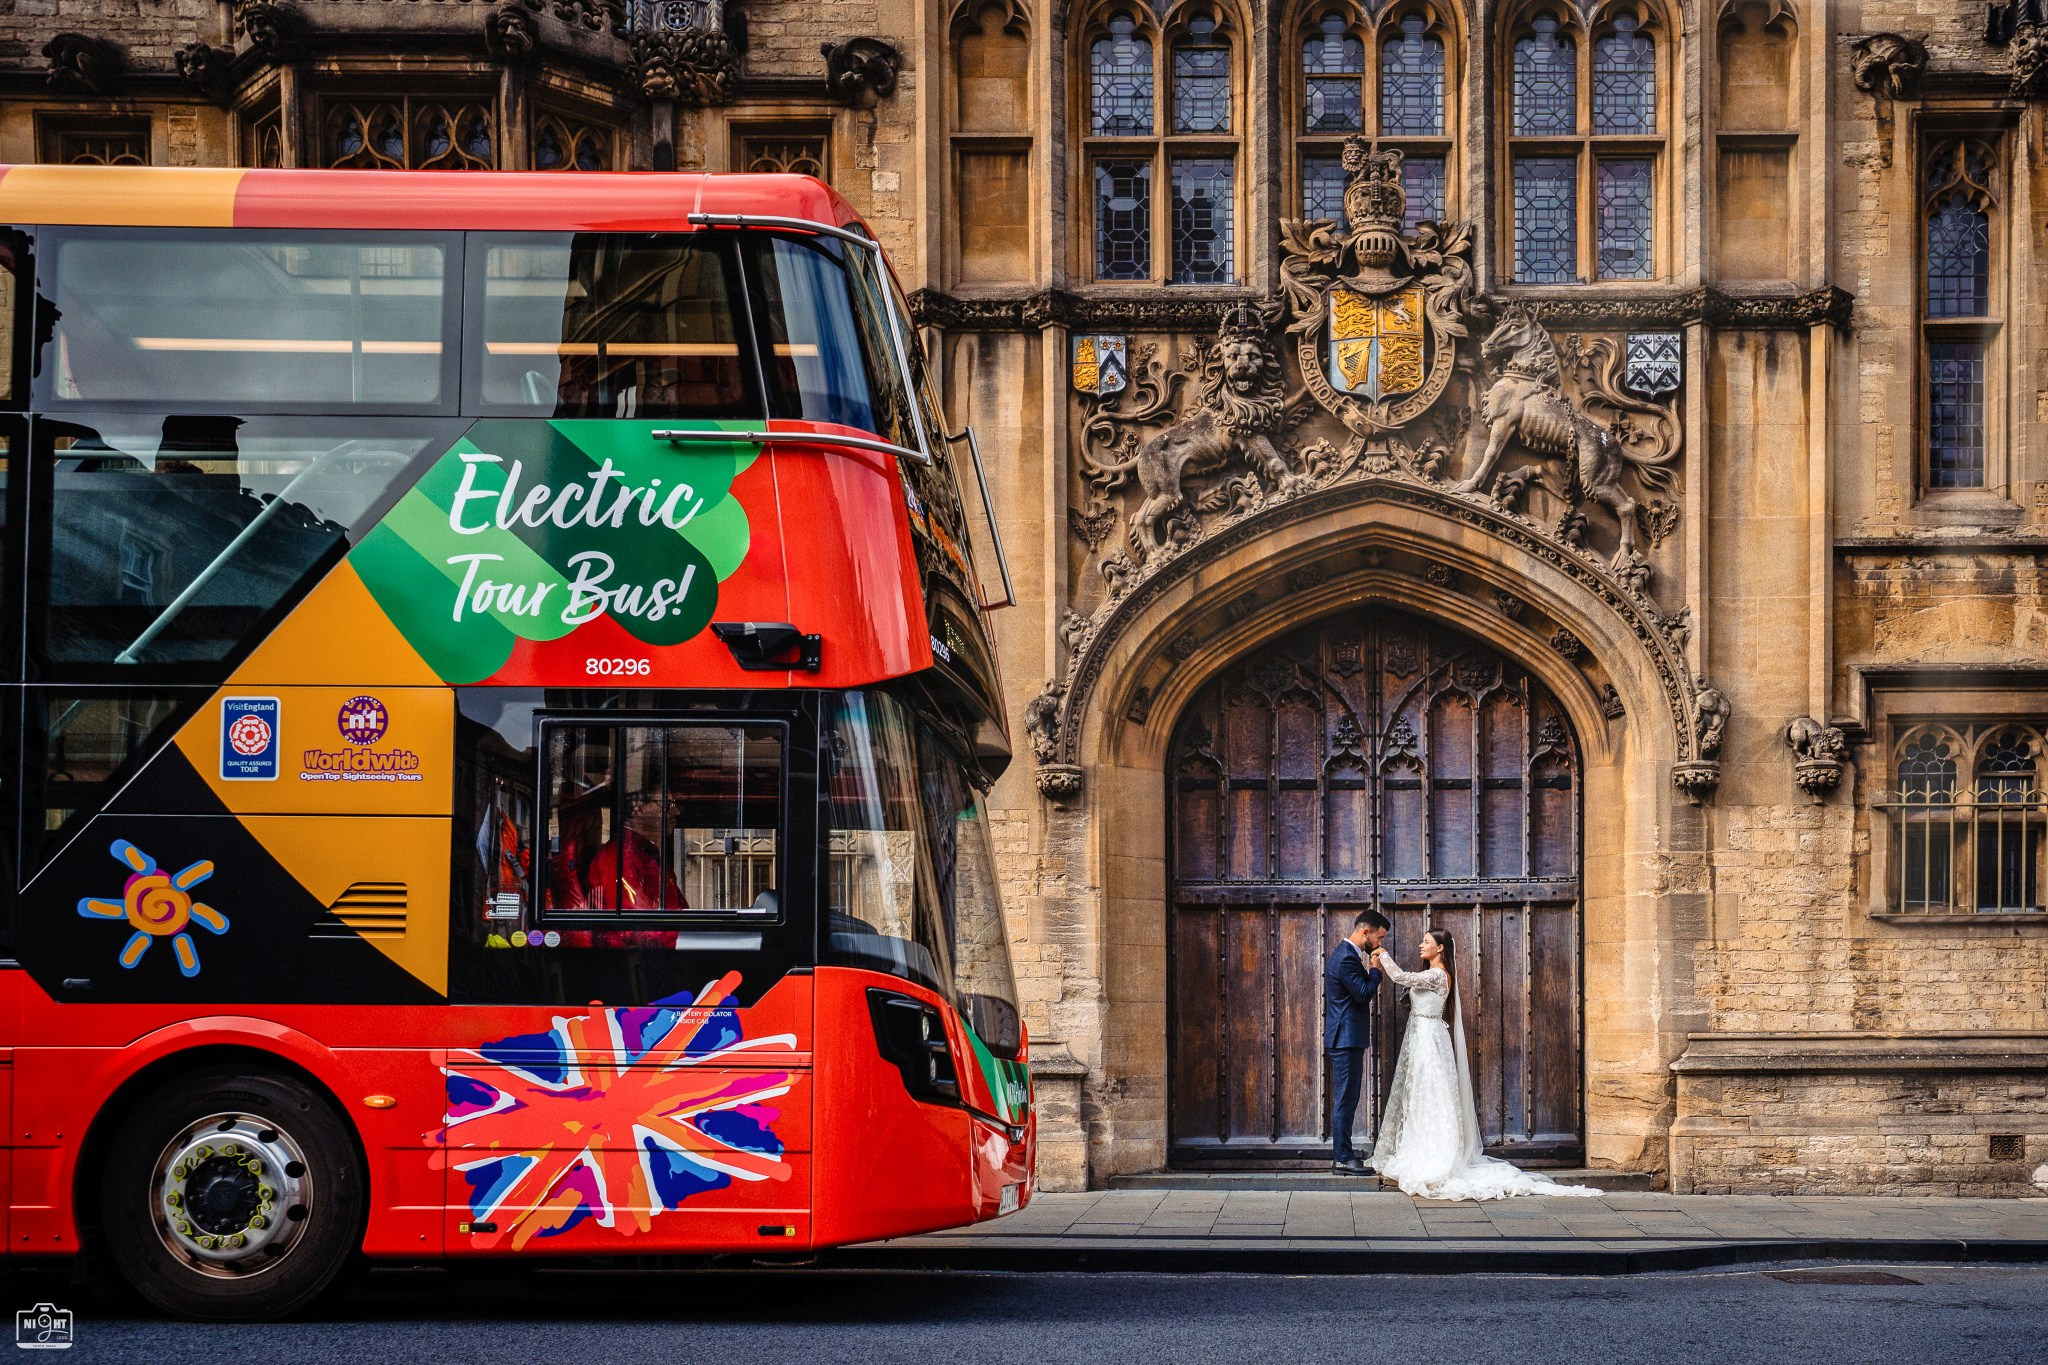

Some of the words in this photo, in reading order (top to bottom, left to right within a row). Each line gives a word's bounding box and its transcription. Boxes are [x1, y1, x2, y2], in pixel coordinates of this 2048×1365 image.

[449, 453, 703, 535] Electric
[446, 553, 557, 623] Tour
[560, 551, 696, 625] Bus!
[585, 658, 651, 675] 80296
[227, 702, 275, 712] VisitEngland
[304, 748, 420, 771] Worldwide
[300, 772, 340, 781] OpenTop
[342, 772, 396, 782] Sightseeing
[397, 772, 422, 781] Tours
